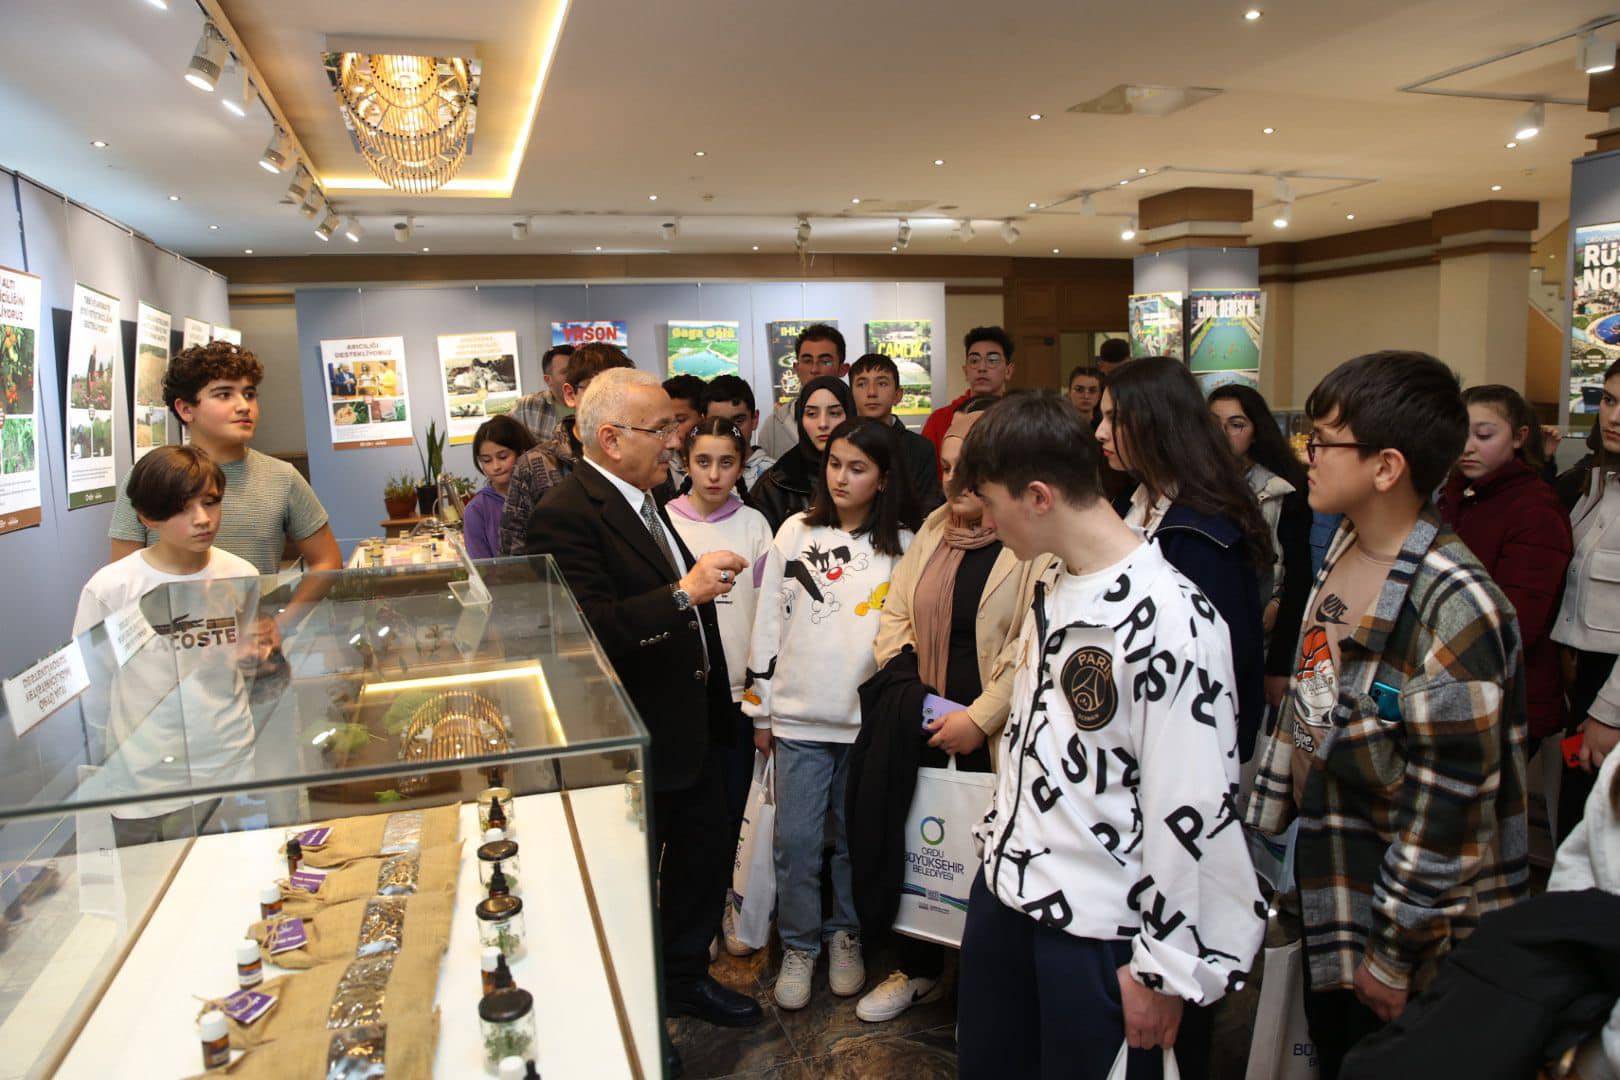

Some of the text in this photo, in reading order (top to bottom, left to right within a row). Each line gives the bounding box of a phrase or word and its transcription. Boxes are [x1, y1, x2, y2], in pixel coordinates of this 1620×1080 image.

[1584, 242, 1620, 267] RÜ
[1583, 266, 1620, 291] NO
[562, 326, 618, 341] YASON
[921, 847, 944, 858] ORDU
